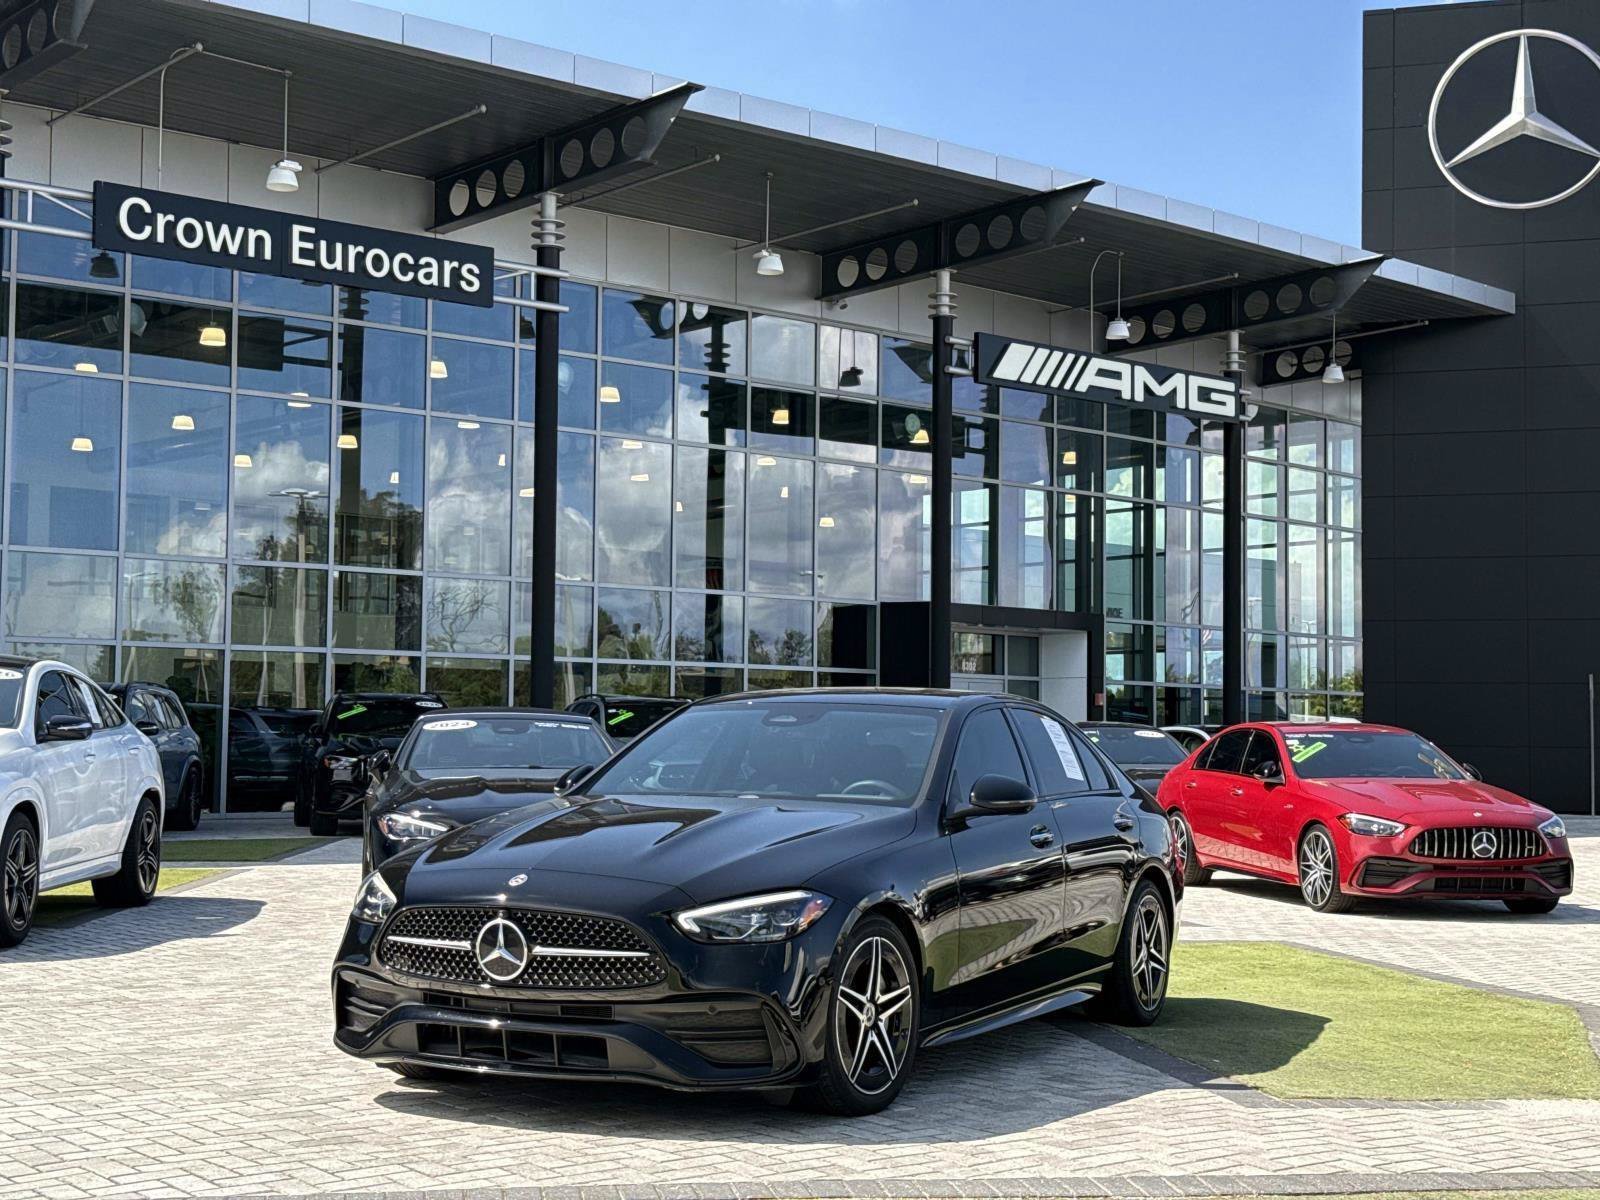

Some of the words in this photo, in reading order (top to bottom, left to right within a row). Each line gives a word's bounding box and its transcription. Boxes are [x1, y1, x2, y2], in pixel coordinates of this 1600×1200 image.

[119, 197, 273, 261] Crown
[291, 223, 481, 293] Eurocars
[1074, 357, 1236, 417] AMG
[429, 721, 472, 729] 2024
